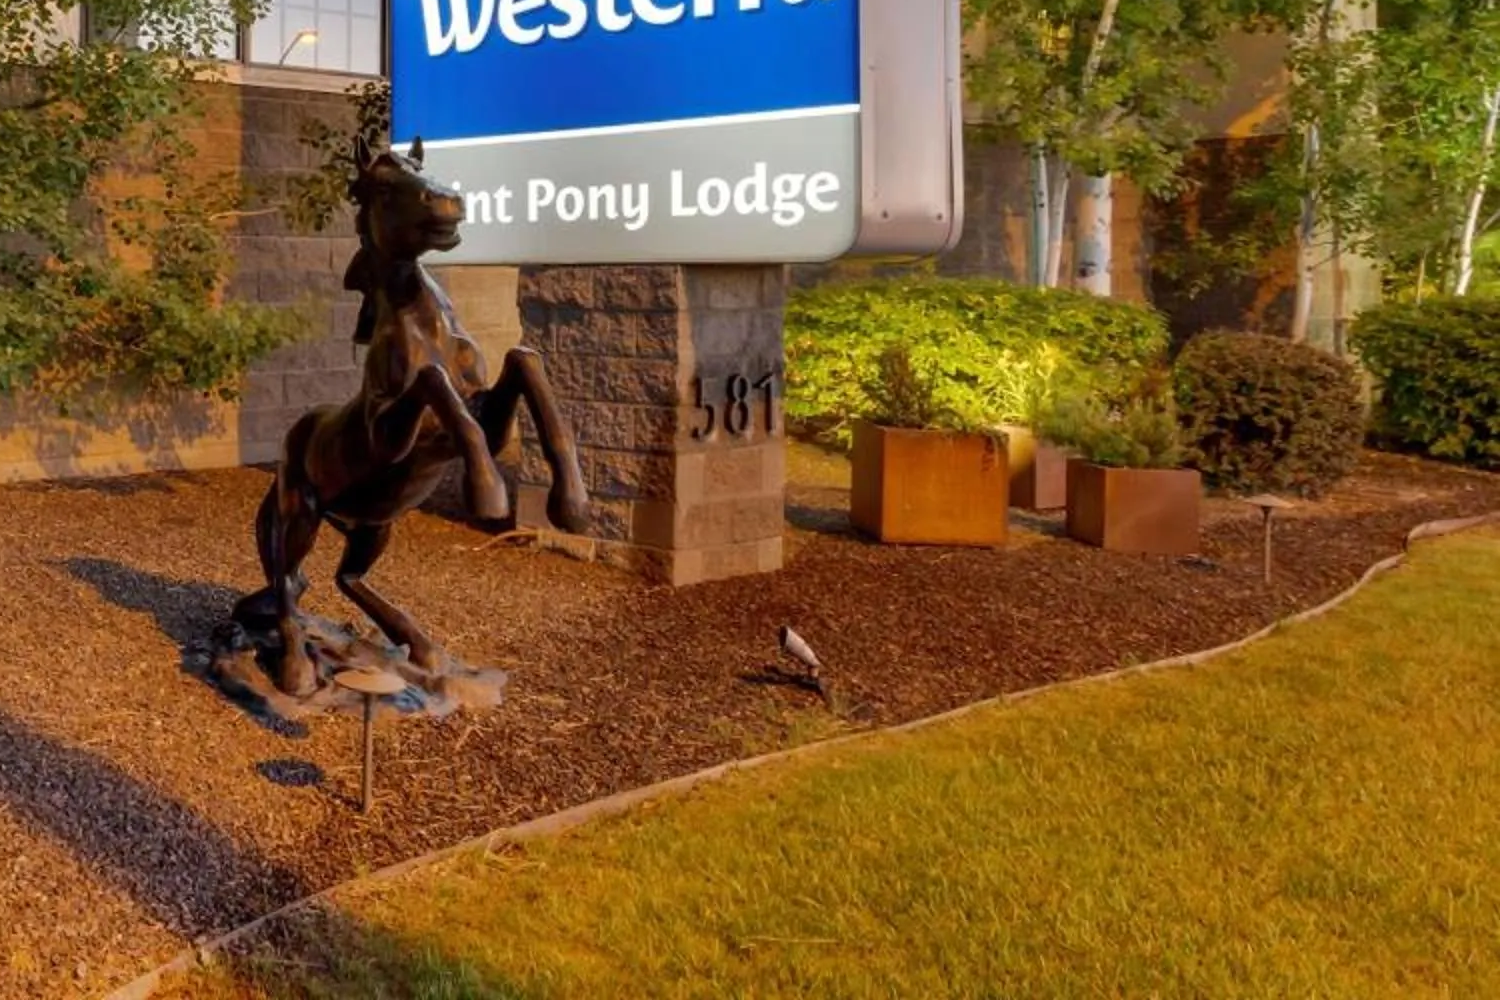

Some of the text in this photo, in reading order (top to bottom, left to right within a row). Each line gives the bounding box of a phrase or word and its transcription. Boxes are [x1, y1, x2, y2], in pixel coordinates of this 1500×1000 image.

[528, 178, 649, 231] Pony
[671, 161, 840, 226] Lodge
[690, 372, 778, 440] 581
